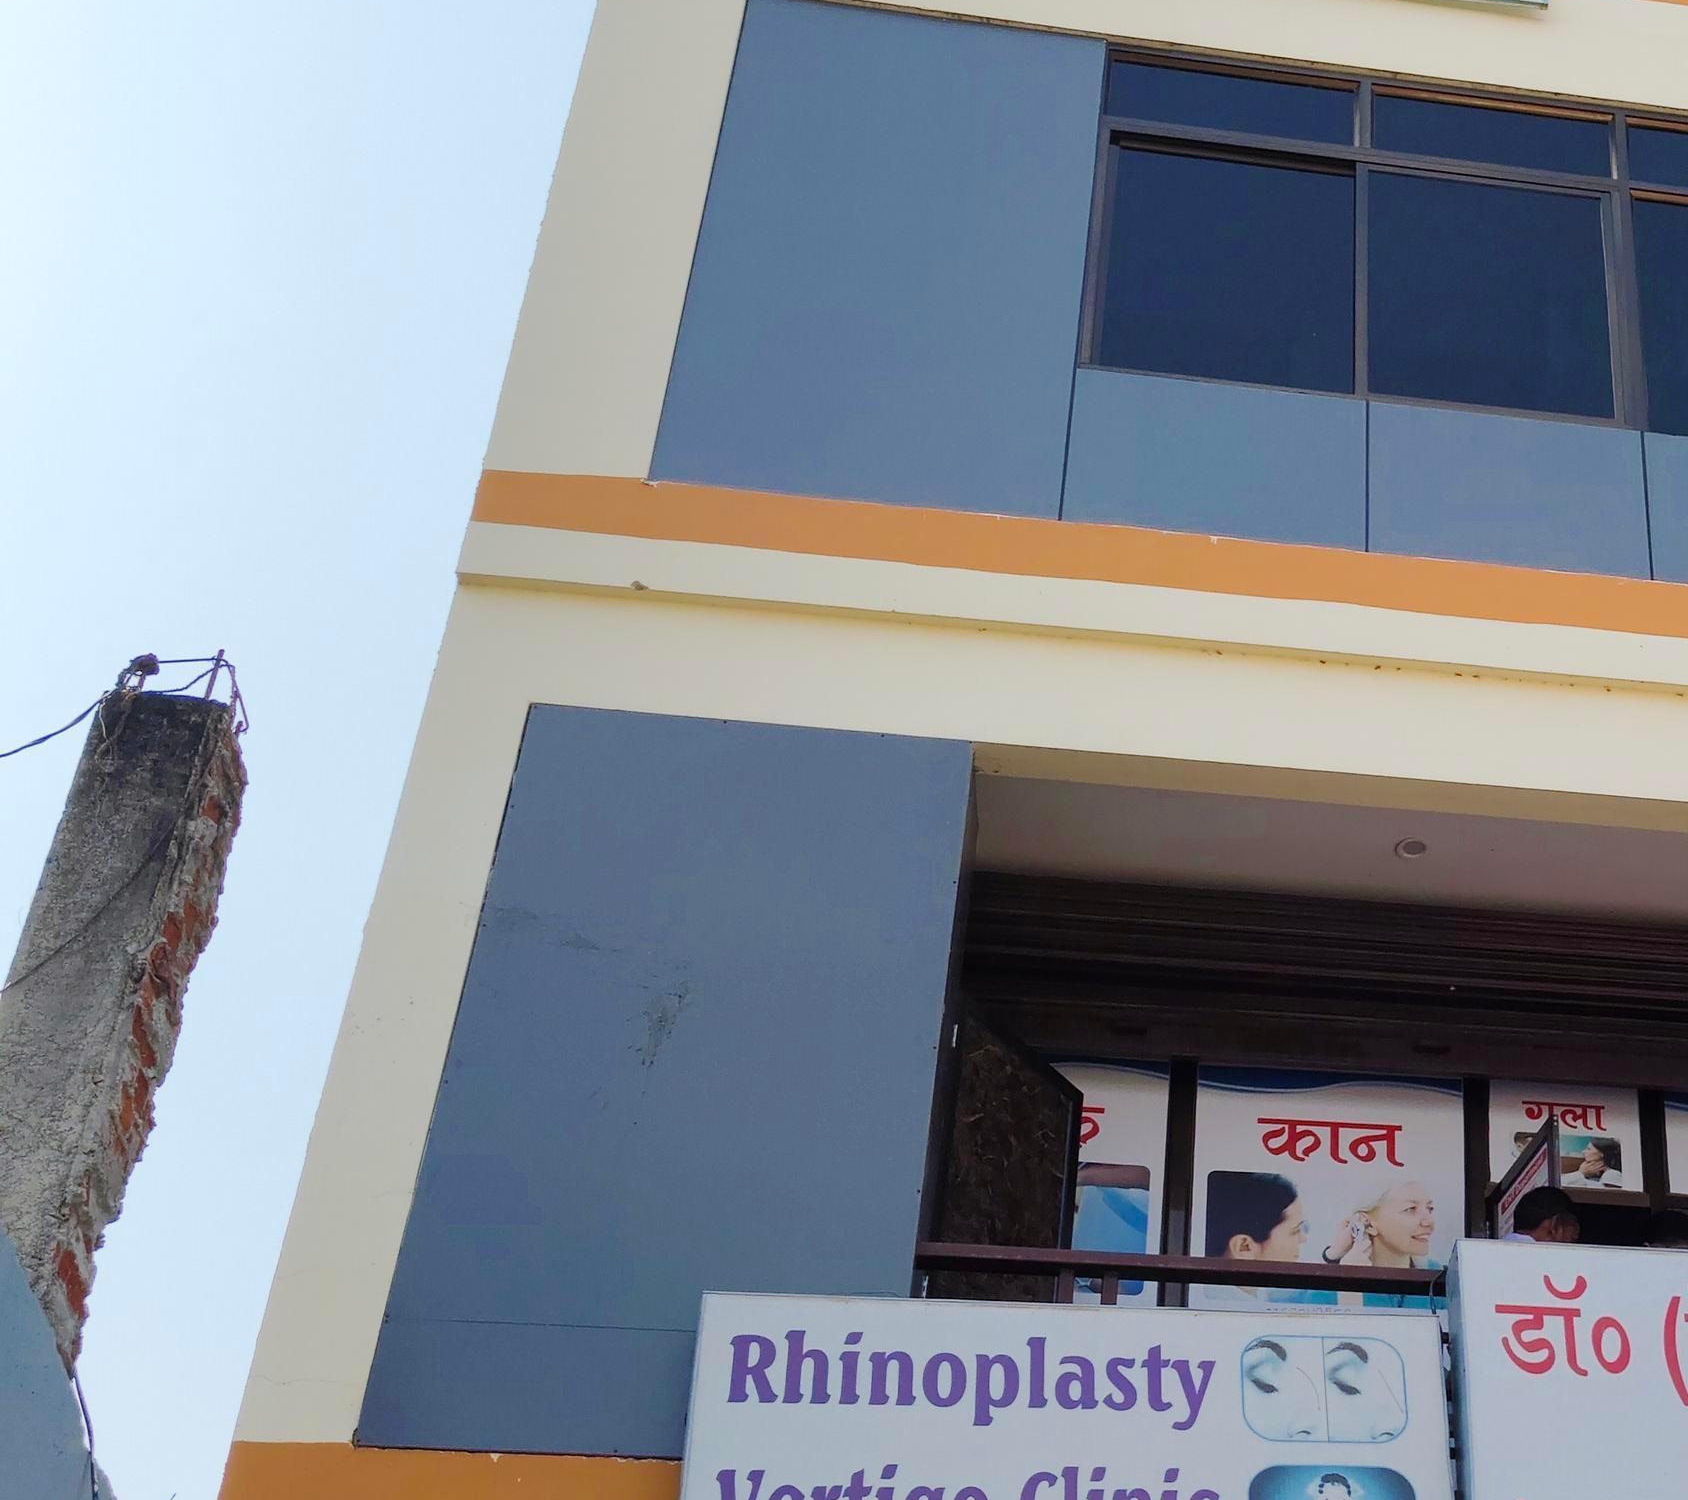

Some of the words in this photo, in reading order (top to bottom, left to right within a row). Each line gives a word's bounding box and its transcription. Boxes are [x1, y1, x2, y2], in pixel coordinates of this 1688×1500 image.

[1258, 1116, 1403, 1170] कान
[1522, 1101, 1607, 1131] गला
[726, 1331, 1216, 1432] Rhinoplasty
